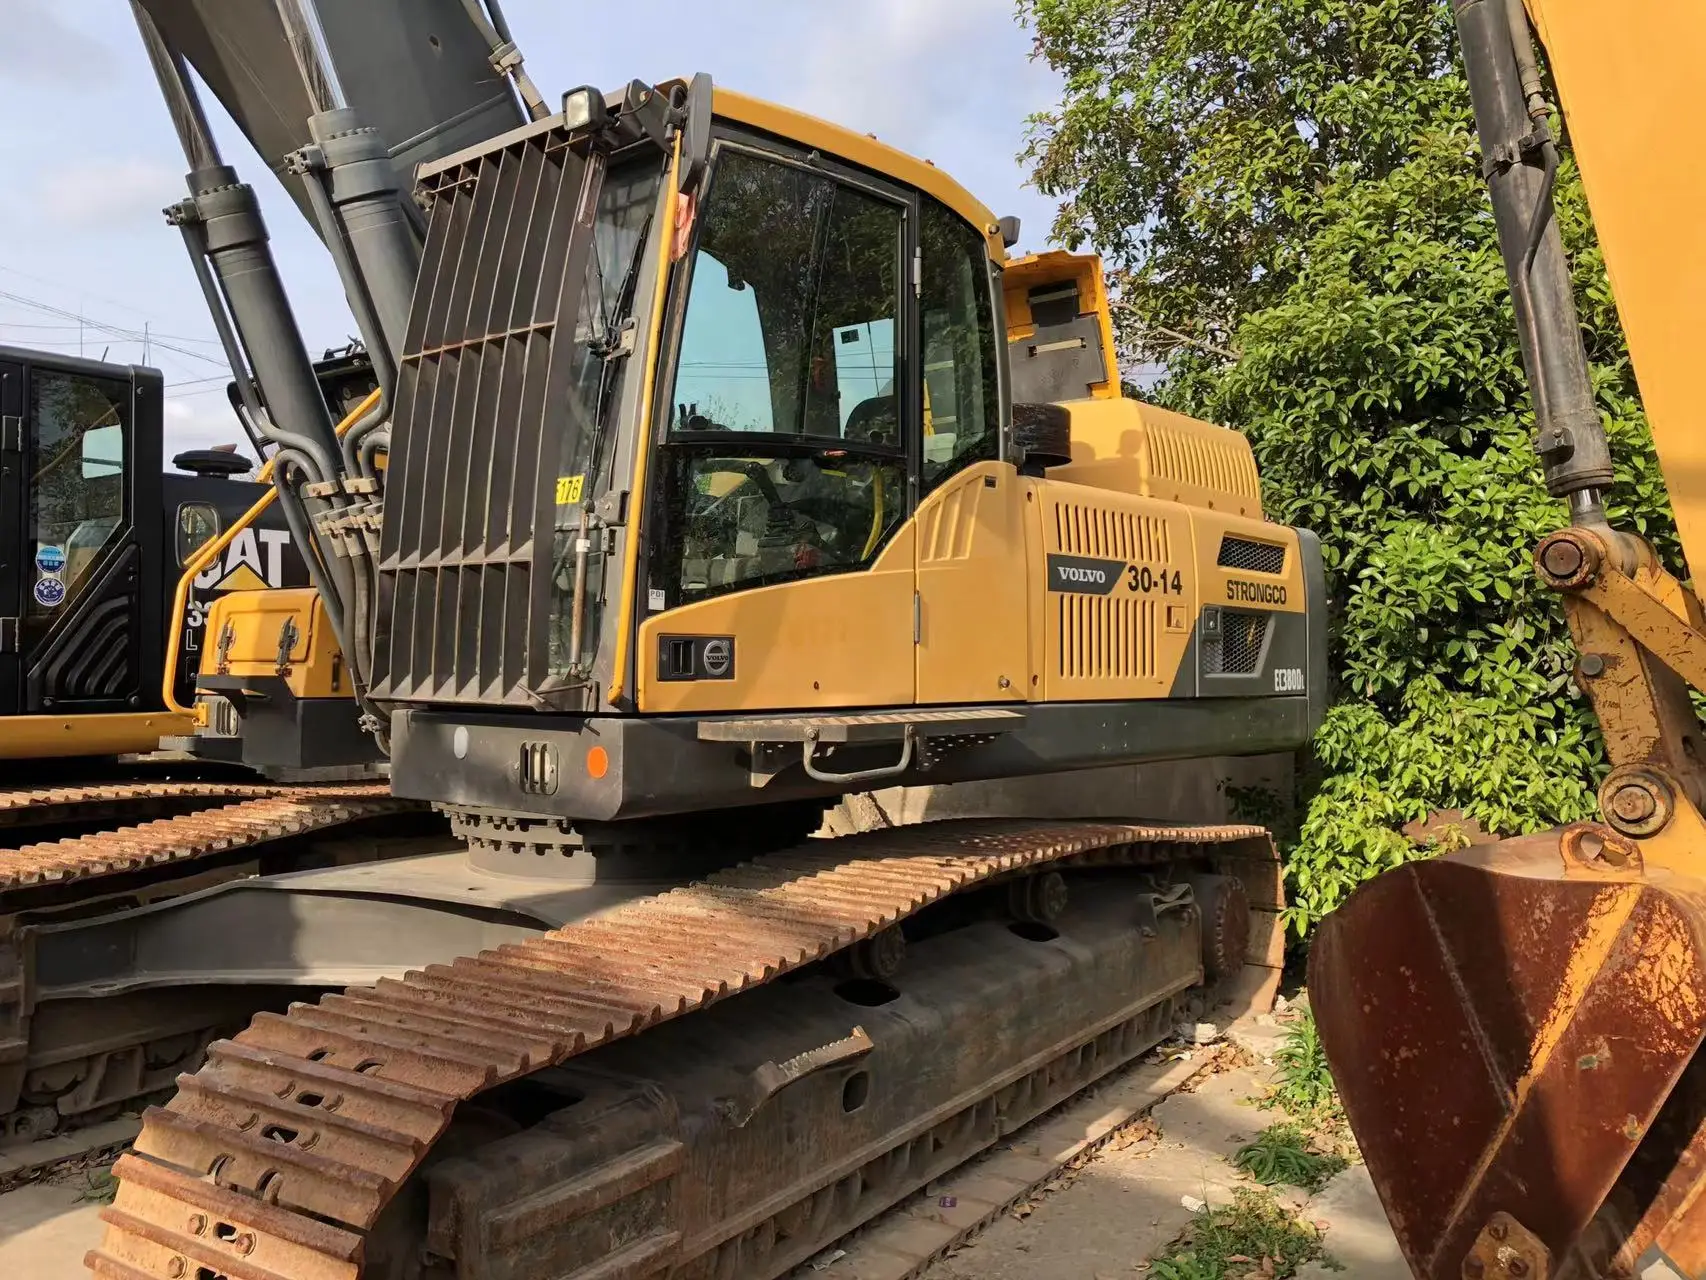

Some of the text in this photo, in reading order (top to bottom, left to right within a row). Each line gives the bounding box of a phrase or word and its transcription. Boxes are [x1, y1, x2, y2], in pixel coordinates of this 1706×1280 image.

[1057, 566, 1106, 584] VOLVO
[1127, 565, 1183, 595] 30-14
[1226, 579, 1287, 605] STRONGCO
[186, 628, 198, 651] L
